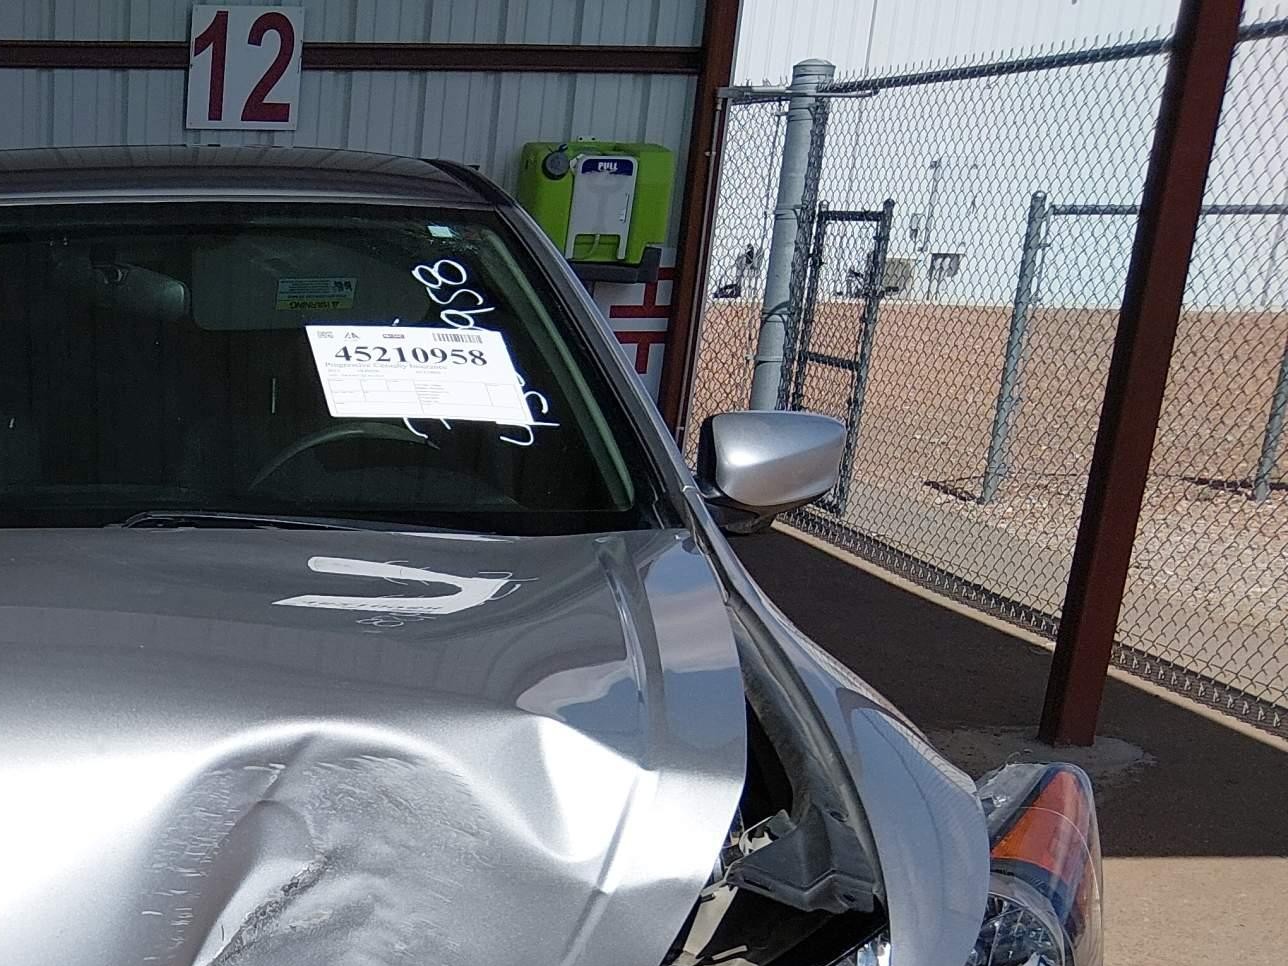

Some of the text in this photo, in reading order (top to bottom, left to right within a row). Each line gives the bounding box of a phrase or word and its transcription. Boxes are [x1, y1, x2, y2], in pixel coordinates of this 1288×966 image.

[193, 10, 295, 122] 12
[597, 161, 618, 171] PULL
[334, 345, 488, 367] 45210958
